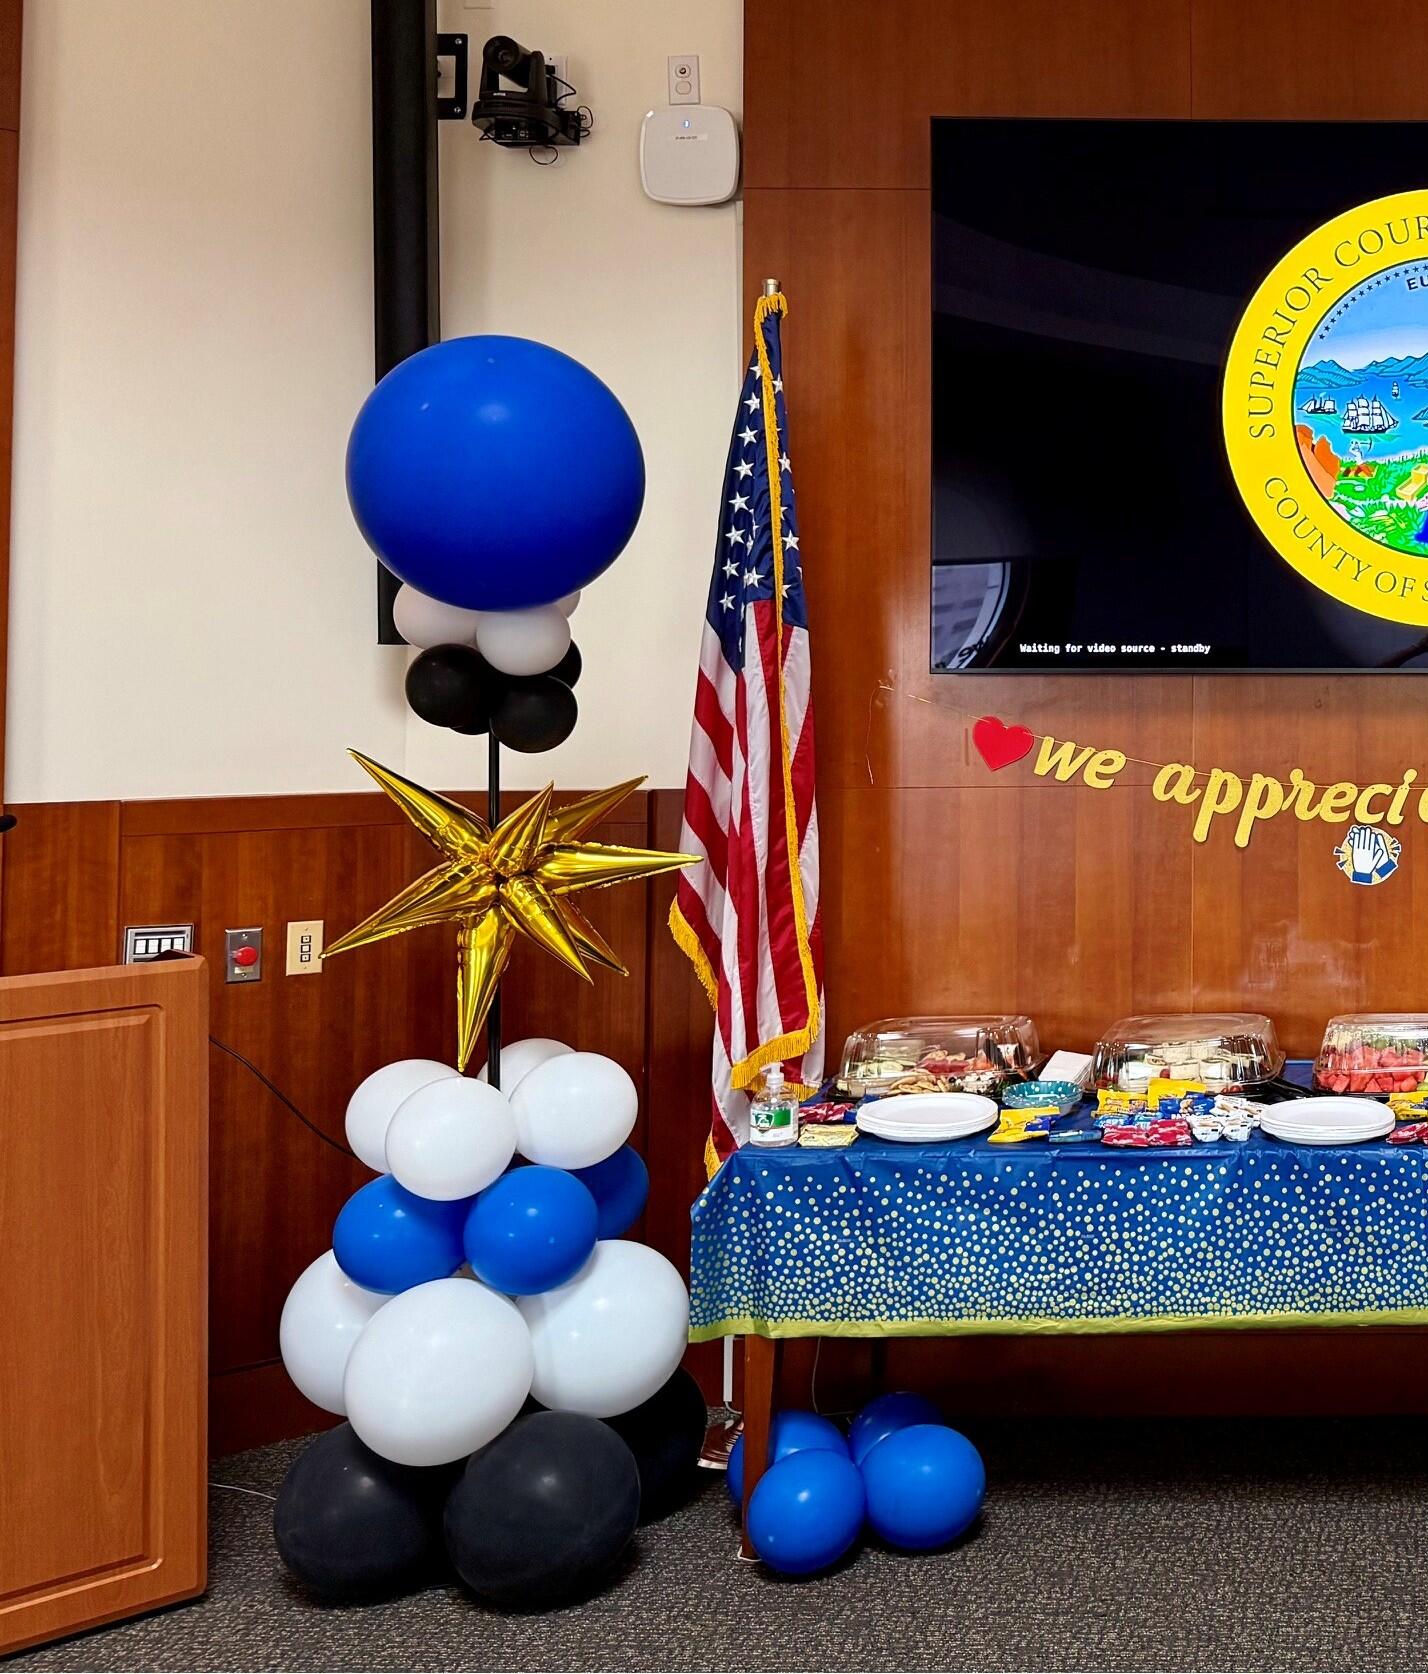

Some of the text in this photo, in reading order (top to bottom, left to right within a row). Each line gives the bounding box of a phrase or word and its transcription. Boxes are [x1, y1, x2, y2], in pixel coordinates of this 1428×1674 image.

[1248, 267, 1333, 439] SUPERIOR
[1263, 476, 1373, 583] COUNTY
[1374, 570, 1417, 598] OF
[1019, 643, 1060, 654] Waiting
[1065, 643, 1083, 653] for
[1087, 643, 1116, 653] video
[1120, 645, 1155, 653] source
[1171, 643, 1211, 654] standby
[1032, 735, 1127, 789] we
